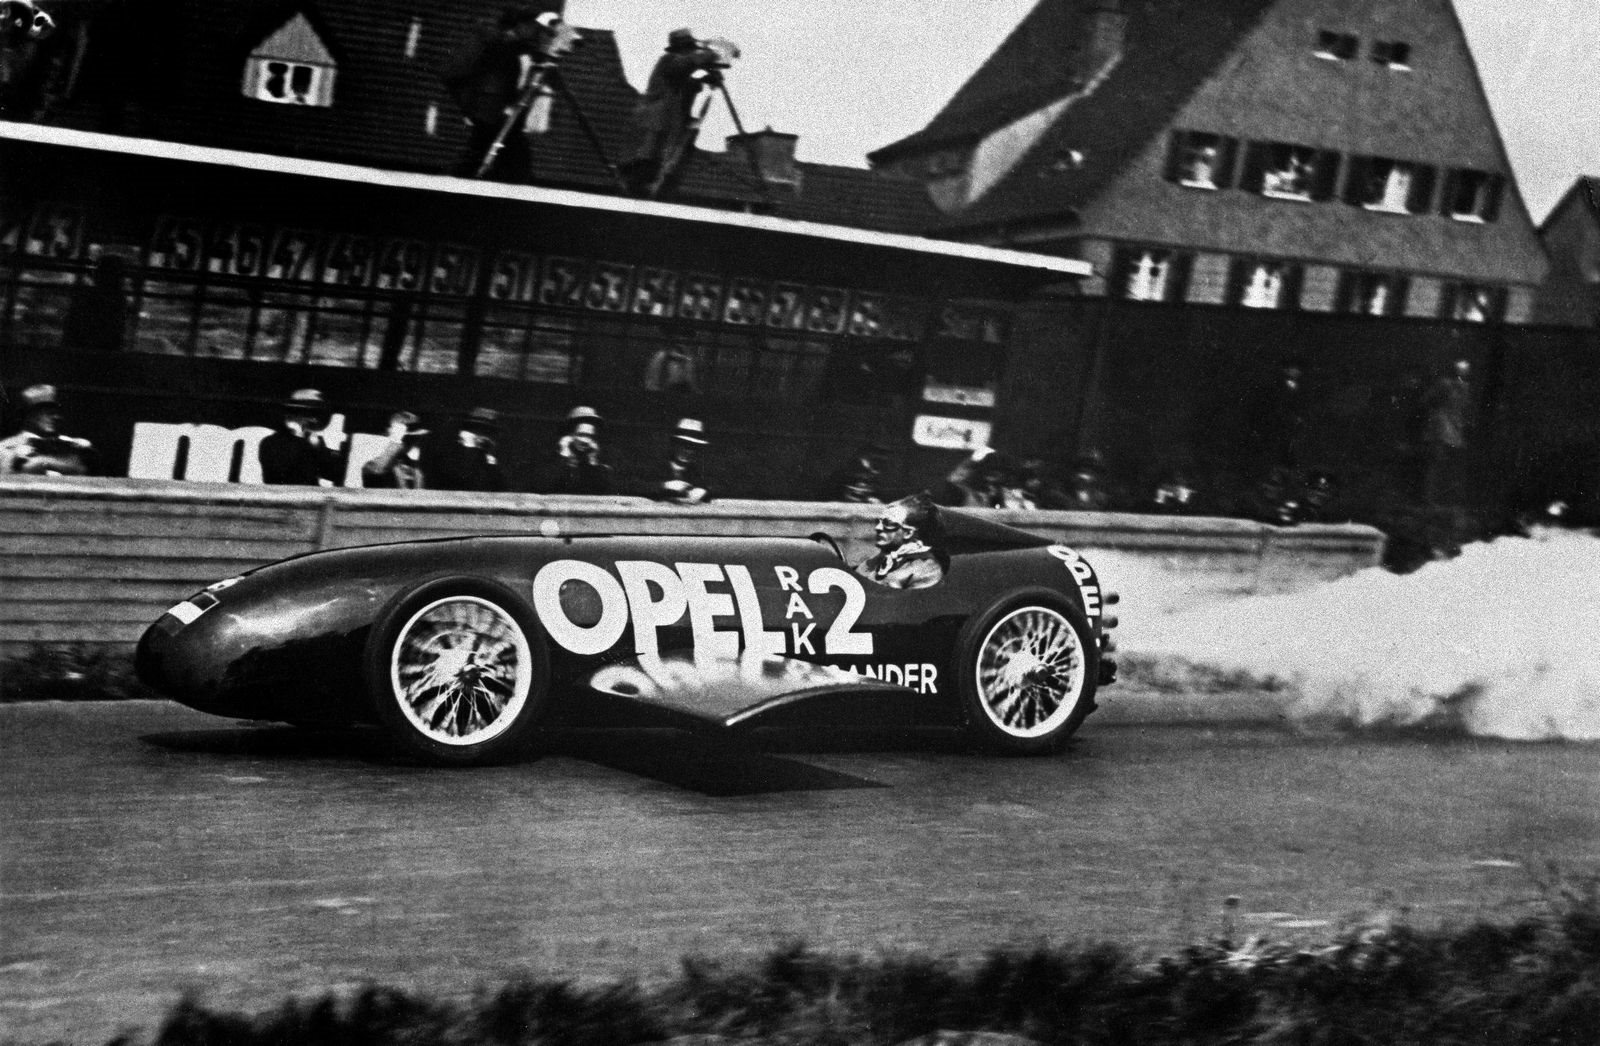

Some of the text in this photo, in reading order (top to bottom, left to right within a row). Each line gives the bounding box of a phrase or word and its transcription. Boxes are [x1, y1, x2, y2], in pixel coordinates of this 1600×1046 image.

[206, 226, 261, 277] 46
[266, 229, 316, 281] 47
[488, 256, 534, 301] 51
[539, 260, 585, 306] 52
[586, 265, 631, 312] 53
[680, 276, 720, 321] 55
[766, 286, 803, 328] 57
[533, 559, 786, 655] OPEL
[774, 565, 874, 656] RAK 2
[828, 663, 938, 695] NDER
